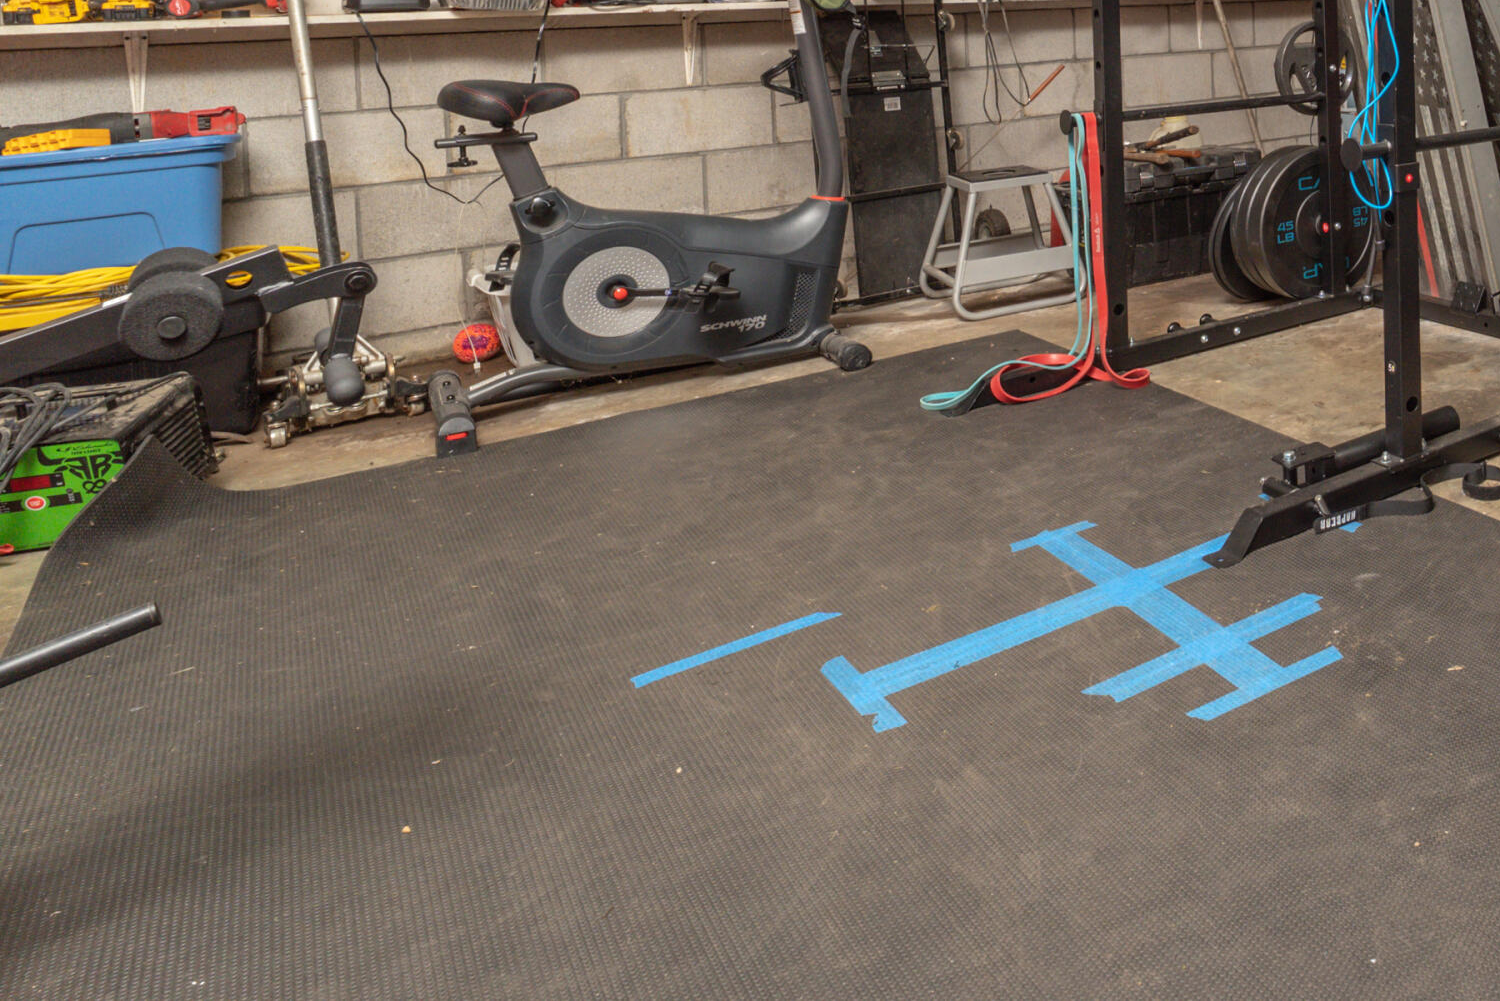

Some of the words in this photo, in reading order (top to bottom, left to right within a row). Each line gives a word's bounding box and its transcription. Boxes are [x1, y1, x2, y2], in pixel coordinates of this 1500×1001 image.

[1277, 220, 1294, 232] 45
[1277, 231, 1295, 244] LB
[700, 314, 768, 333] SCHWINN
